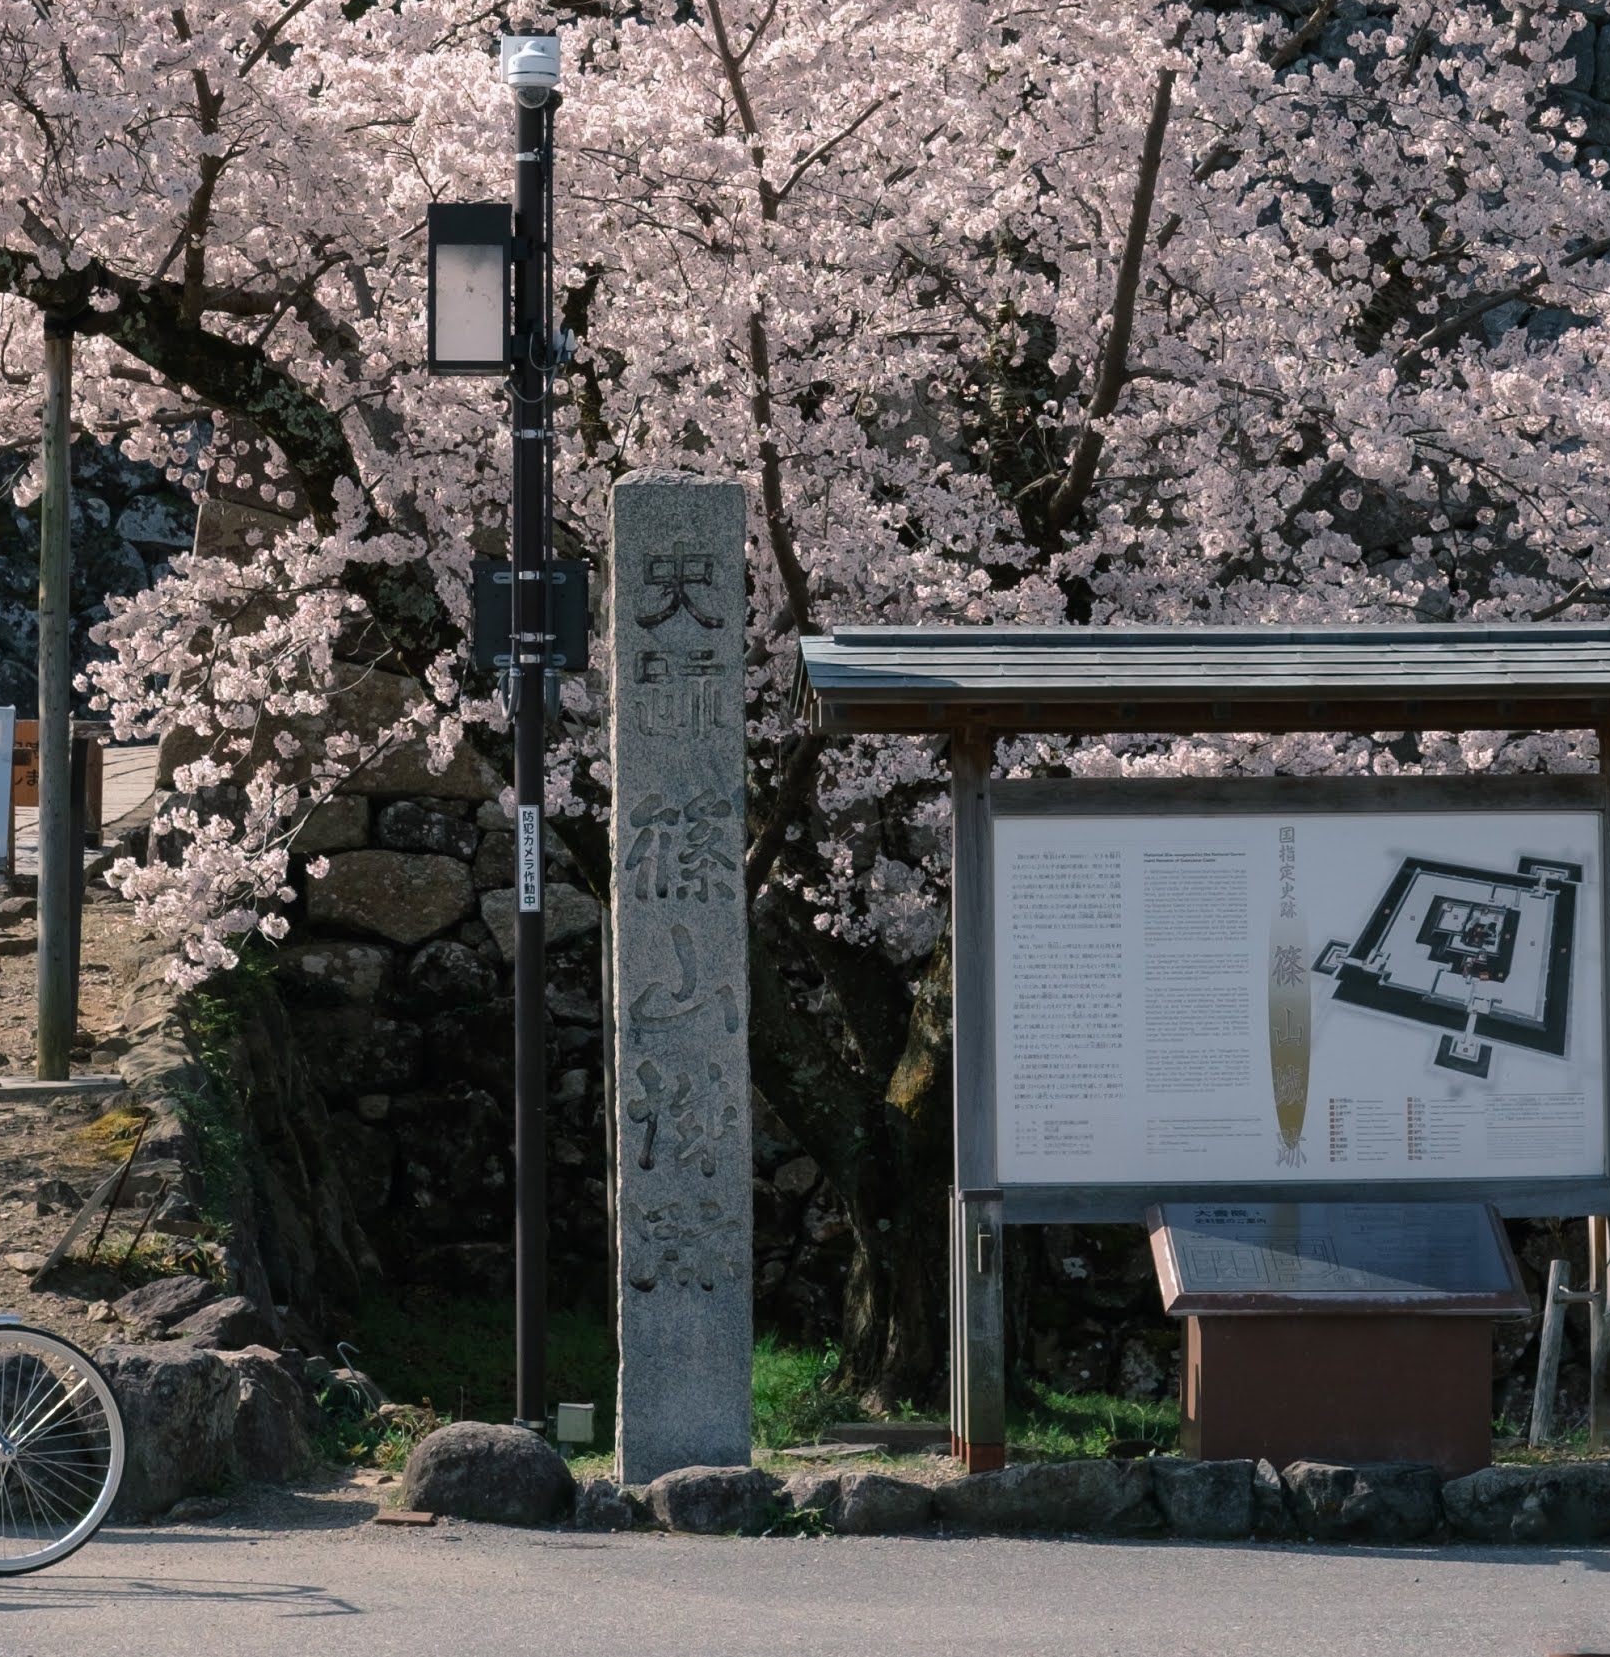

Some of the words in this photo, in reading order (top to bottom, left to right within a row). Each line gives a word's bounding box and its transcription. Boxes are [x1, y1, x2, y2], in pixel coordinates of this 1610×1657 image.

[634, 541, 726, 740] 史跡
[522, 810, 536, 907] 防犯カメラ作動中
[1279, 826, 1298, 919] 国指定史跡
[1271, 945, 1308, 1169] 篠山城跡
